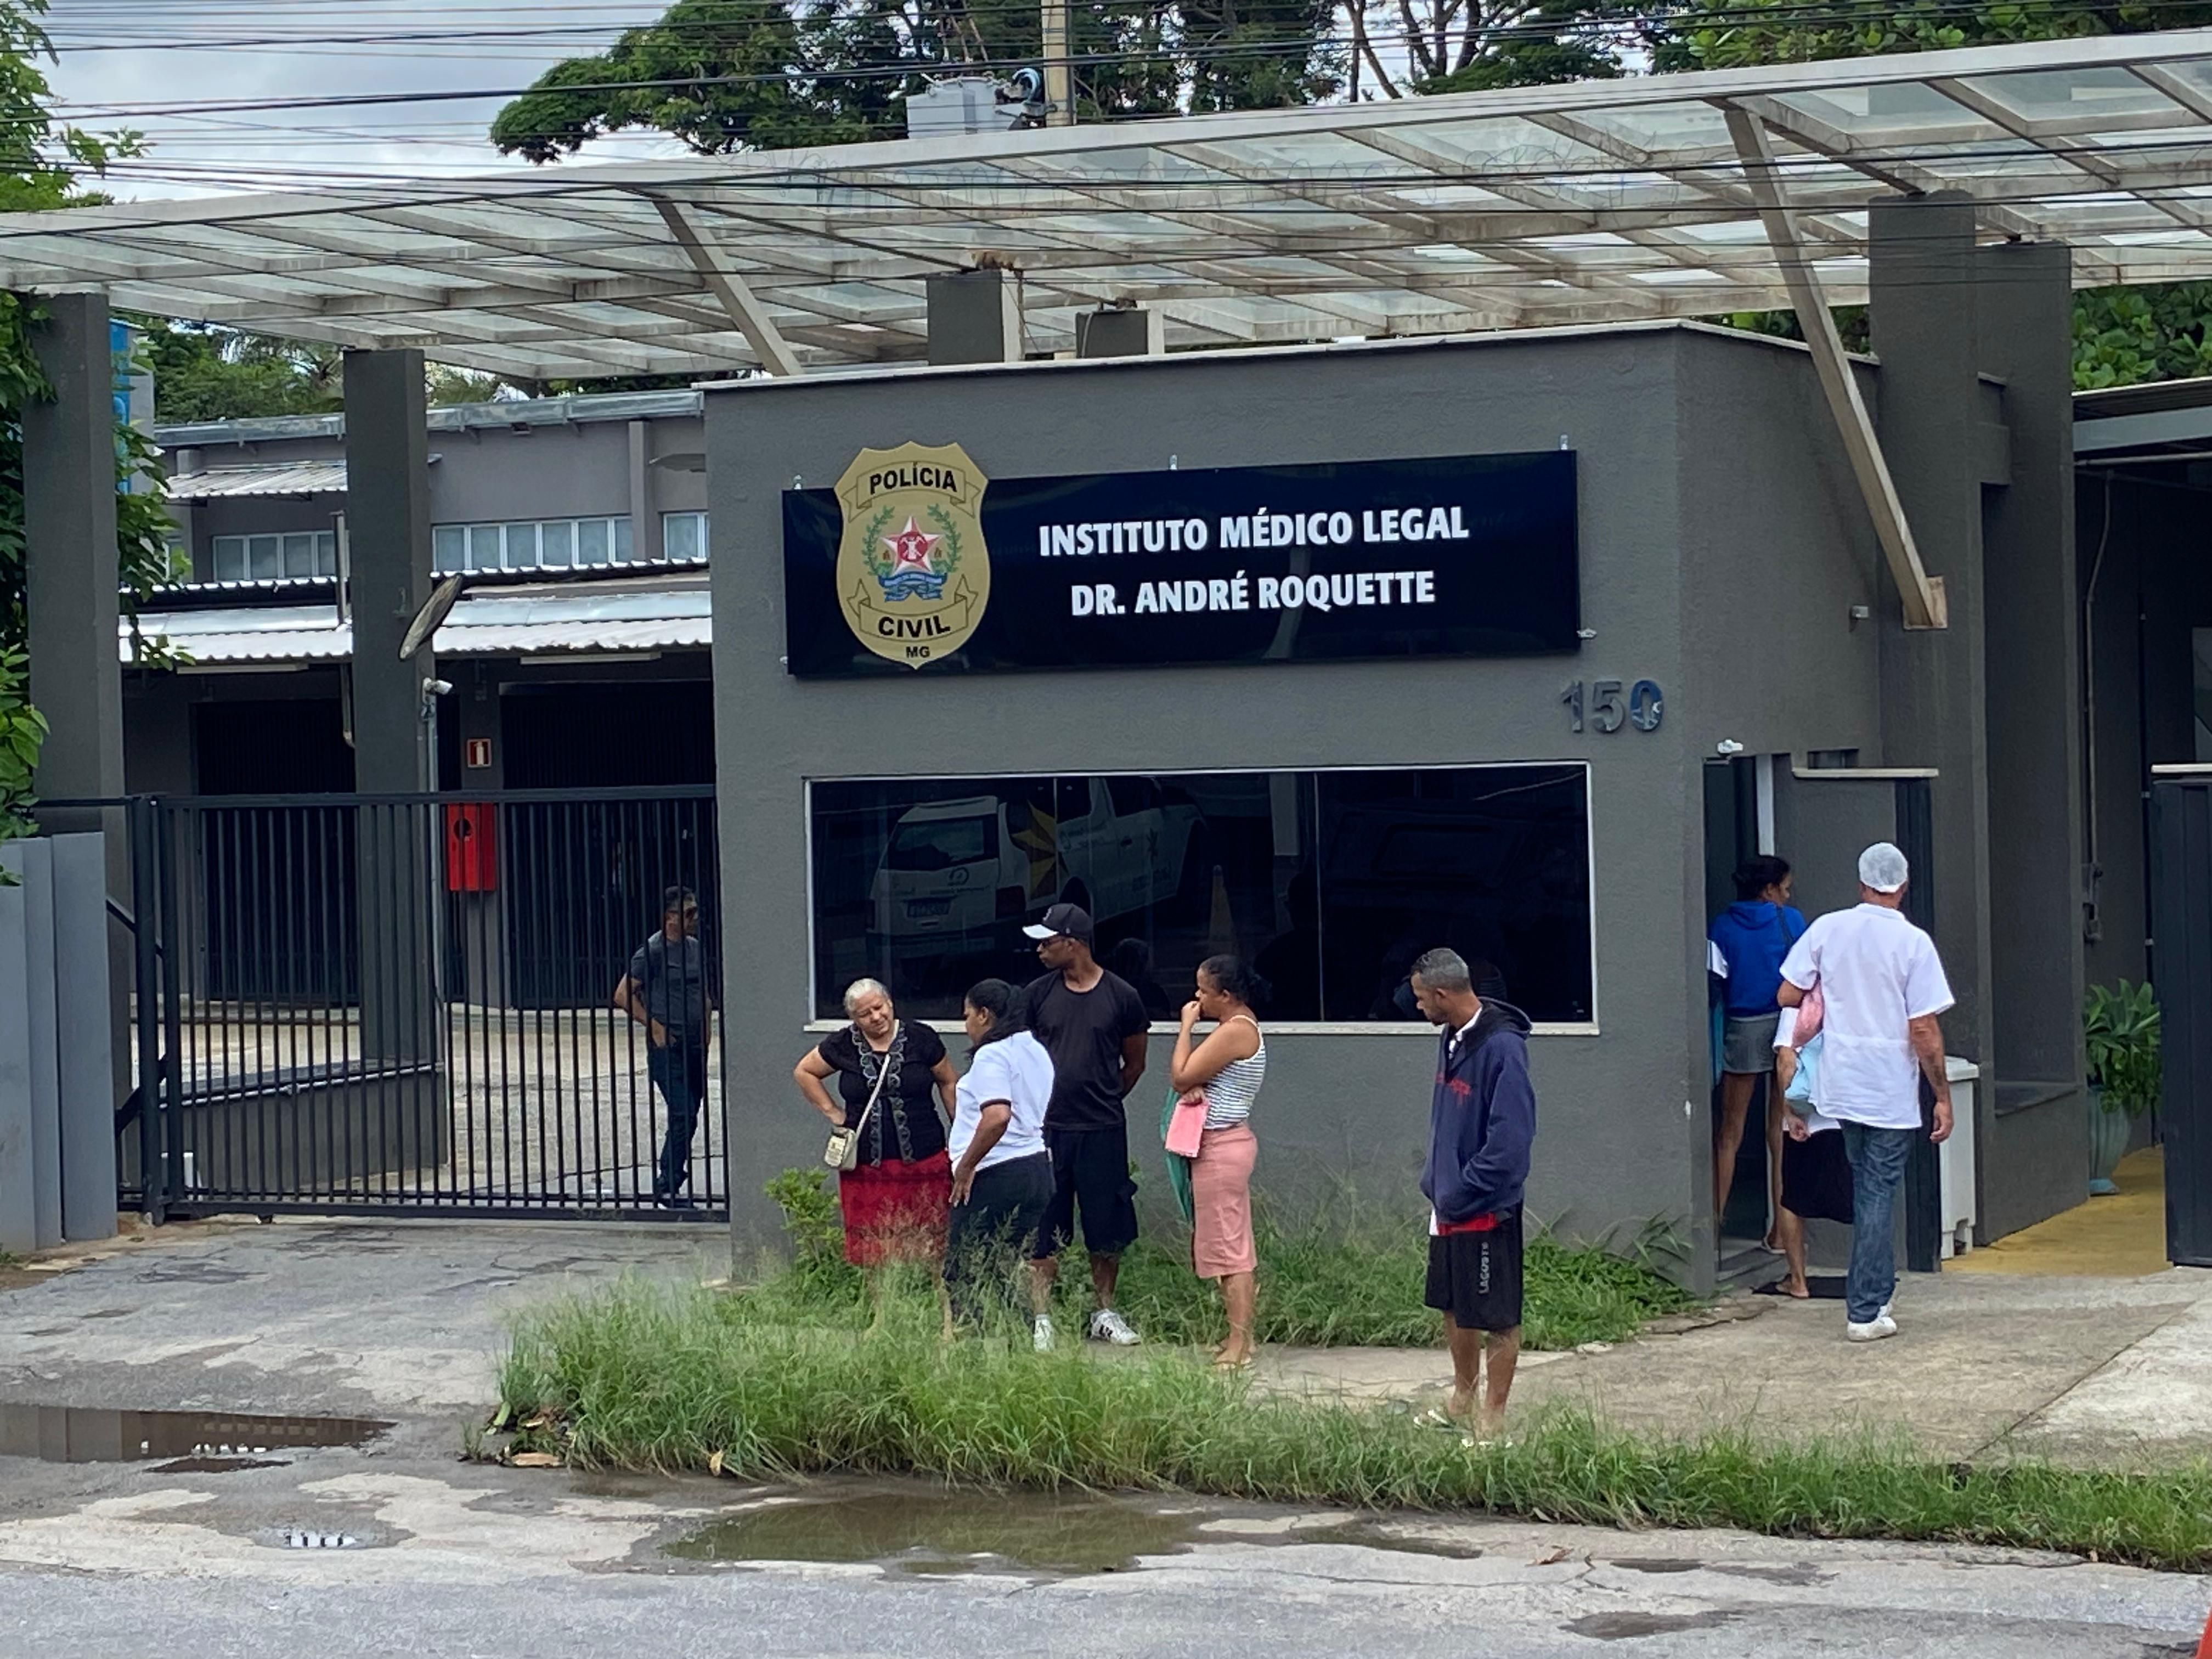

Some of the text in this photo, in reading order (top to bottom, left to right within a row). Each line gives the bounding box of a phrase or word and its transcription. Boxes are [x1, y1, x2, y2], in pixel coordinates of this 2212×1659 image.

[870, 461, 957, 495] POLÍCIA
[1039, 506, 1470, 556] INSTITUTO MÉDICO LEGAL
[1071, 570, 1436, 616] DR. ANDRÉ ROQUETTE
[878, 615, 951, 638] CIVIL
[906, 646, 930, 658] MG
[1561, 679, 1665, 733] 150
